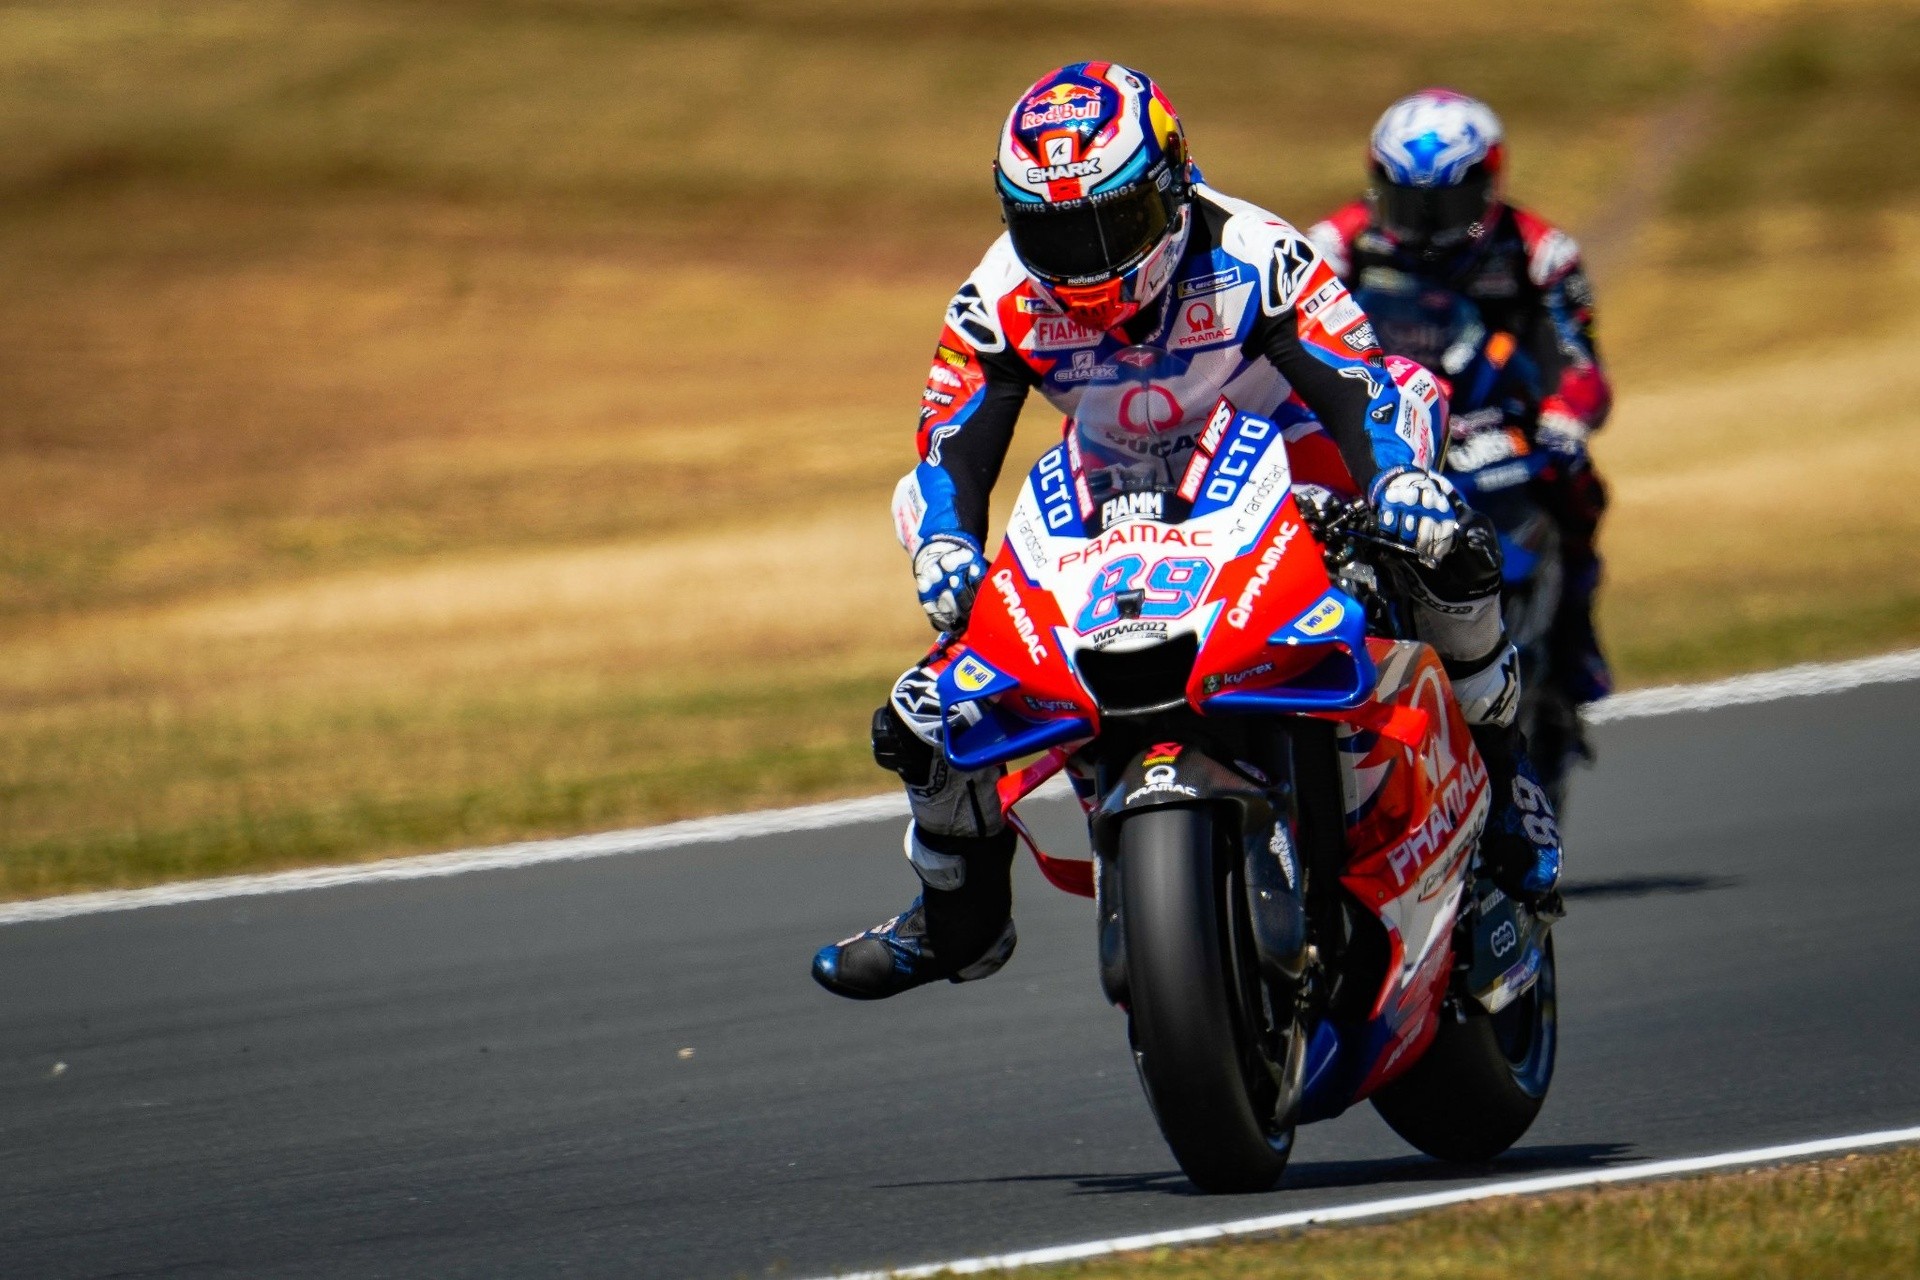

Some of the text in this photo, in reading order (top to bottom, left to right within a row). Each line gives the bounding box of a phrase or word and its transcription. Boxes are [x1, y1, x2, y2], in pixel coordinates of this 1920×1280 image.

[1022, 100, 1101, 130] Red Bull
[1027, 157, 1102, 184] SHARK
[1014, 182, 1137, 213] GIVES YOU WINGS
[1179, 327, 1233, 346] PRAMAC
[1054, 366, 1118, 382] SHARK
[1205, 416, 1270, 502] OCTO
[1038, 447, 1074, 530] OCTO
[1244, 464, 1288, 516] randstad
[1101, 491, 1164, 530] FIAMM
[1057, 524, 1214, 573] PRAMAC
[1236, 520, 1300, 613] PRAMAC
[1073, 553, 1215, 637] 89
[997, 580, 1048, 666] PRAMAC
[1305, 603, 1337, 629] WD-40
[962, 661, 988, 684] WD-40
[1223, 661, 1274, 685] kyrrex
[1126, 783, 1197, 805] PRAMAC
[1511, 773, 1558, 848] 89
